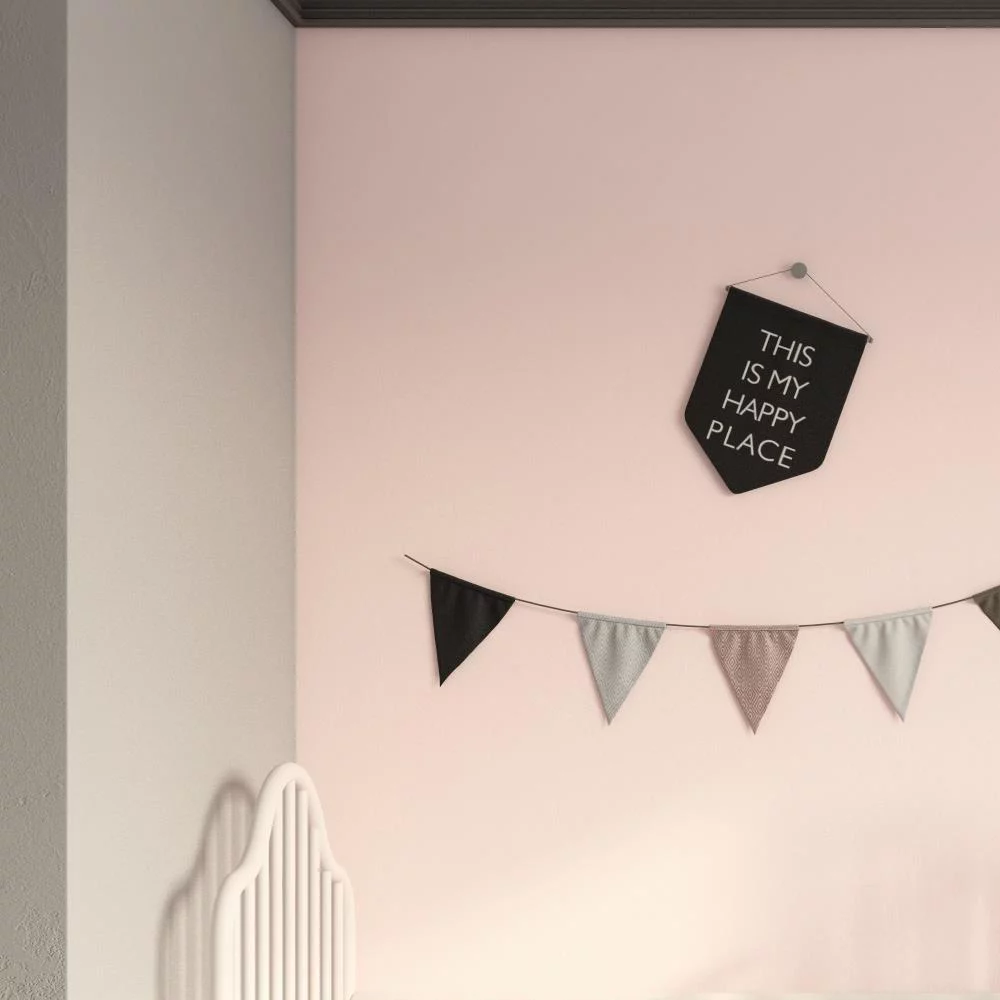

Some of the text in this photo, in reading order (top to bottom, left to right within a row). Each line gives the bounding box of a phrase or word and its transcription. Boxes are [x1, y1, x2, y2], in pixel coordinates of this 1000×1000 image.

[760, 328, 816, 368] THIS
[741, 360, 810, 400] IS MY
[721, 388, 807, 434] HAPPY
[706, 419, 796, 469] PLACE
